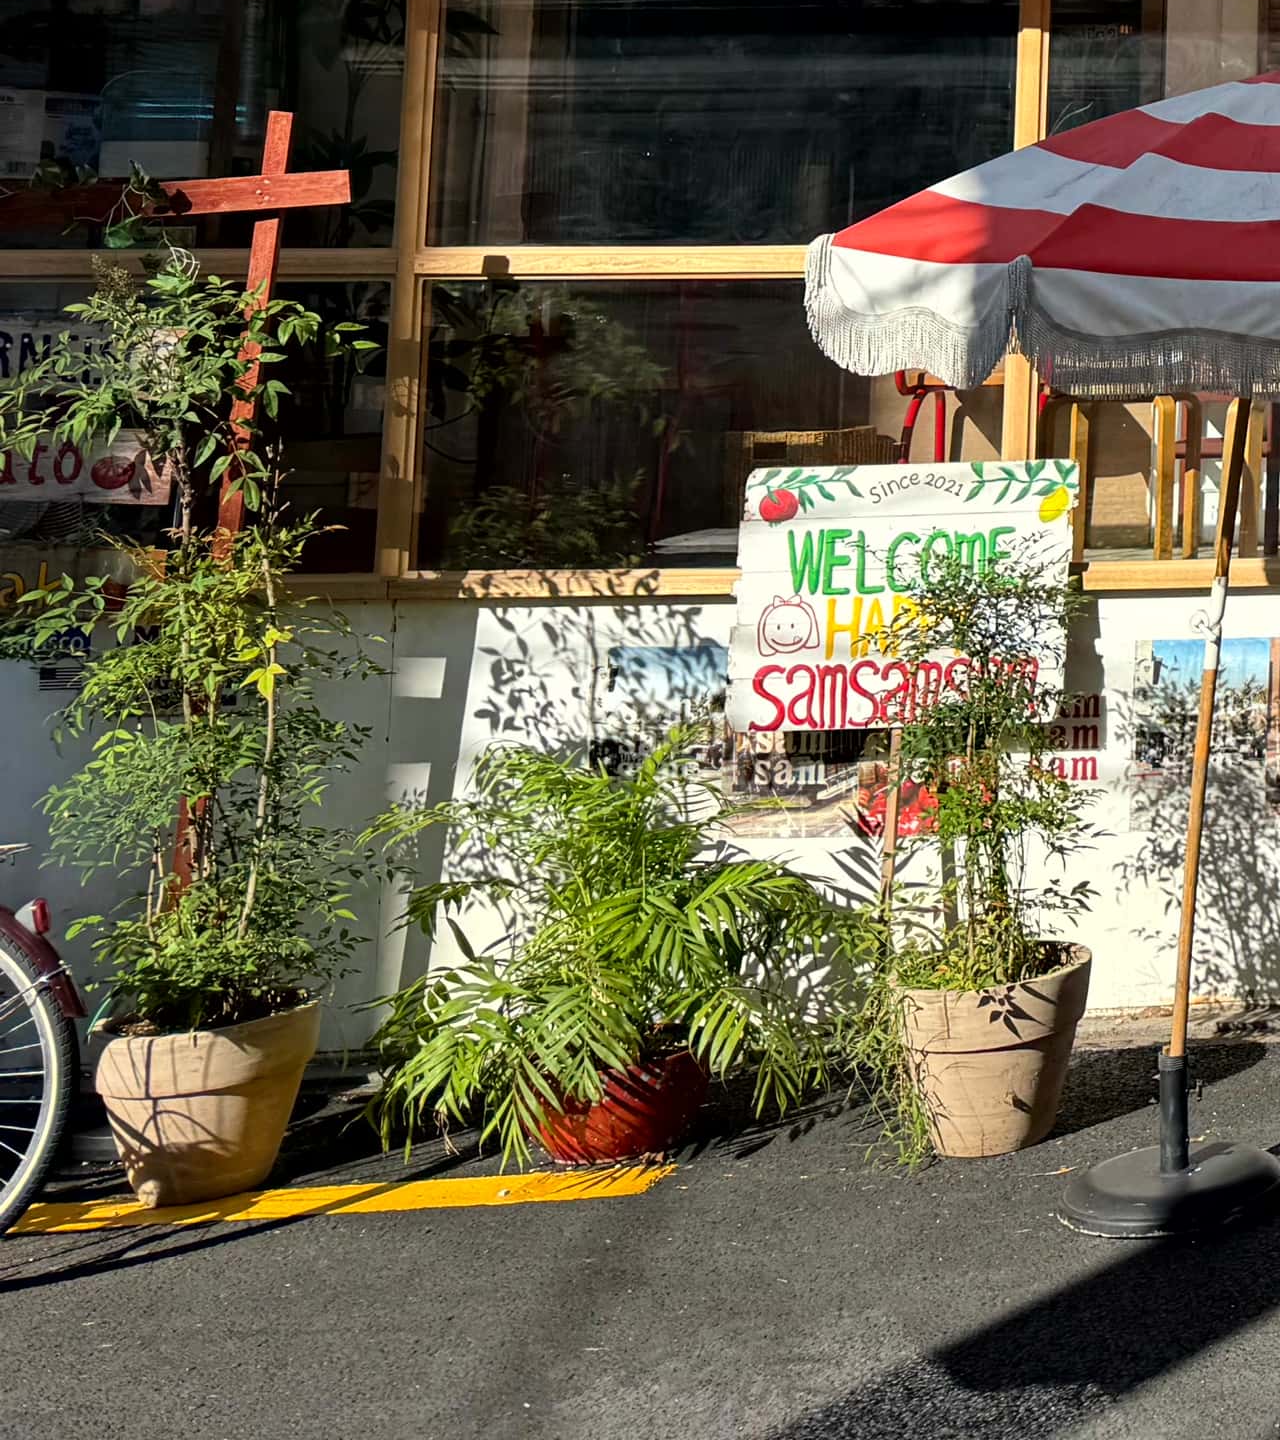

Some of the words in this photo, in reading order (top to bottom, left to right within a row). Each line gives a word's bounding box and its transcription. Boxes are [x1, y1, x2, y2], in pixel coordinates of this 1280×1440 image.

[925, 472, 965, 498] 2021
[1048, 724, 1098, 749] am
[754, 759, 827, 785] sam
[1050, 757, 1097, 781] am
